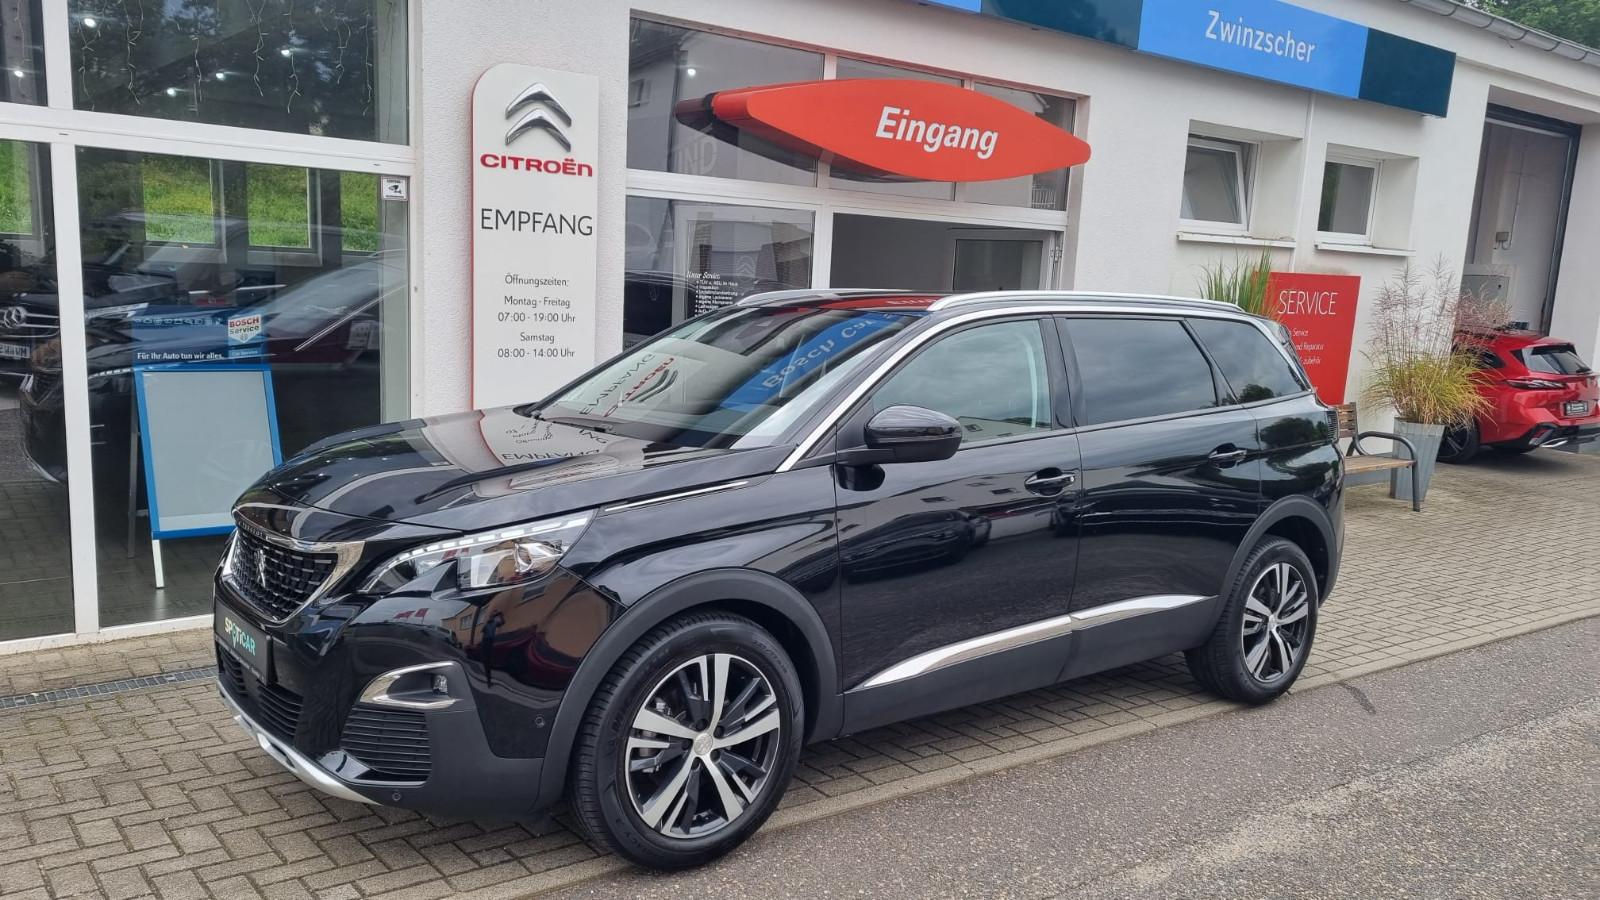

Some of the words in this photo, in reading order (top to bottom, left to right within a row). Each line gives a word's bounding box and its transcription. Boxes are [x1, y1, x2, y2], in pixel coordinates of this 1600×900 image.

[1205, 10, 1316, 62] Zwinzscher
[876, 106, 999, 160] Eingang
[481, 208, 593, 236] EMPFANG
[504, 296, 537, 309] Montag
[543, 297, 571, 309] Freitag
[1278, 290, 1338, 315] SERVICE
[229, 317, 260, 328] BOSCH
[497, 312, 526, 322] 07:00
[533, 313, 559, 322] 19:00
[561, 313, 576, 322] Uhr
[520, 332, 555, 345] Samstag
[137, 352, 150, 360] Für
[151, 352, 162, 360] Ihr
[162, 352, 180, 360] Auto
[194, 352, 205, 360] wir
[497, 348, 525, 358] 08:00
[533, 348, 558, 358] 14:00
[560, 348, 575, 358] Uhr
